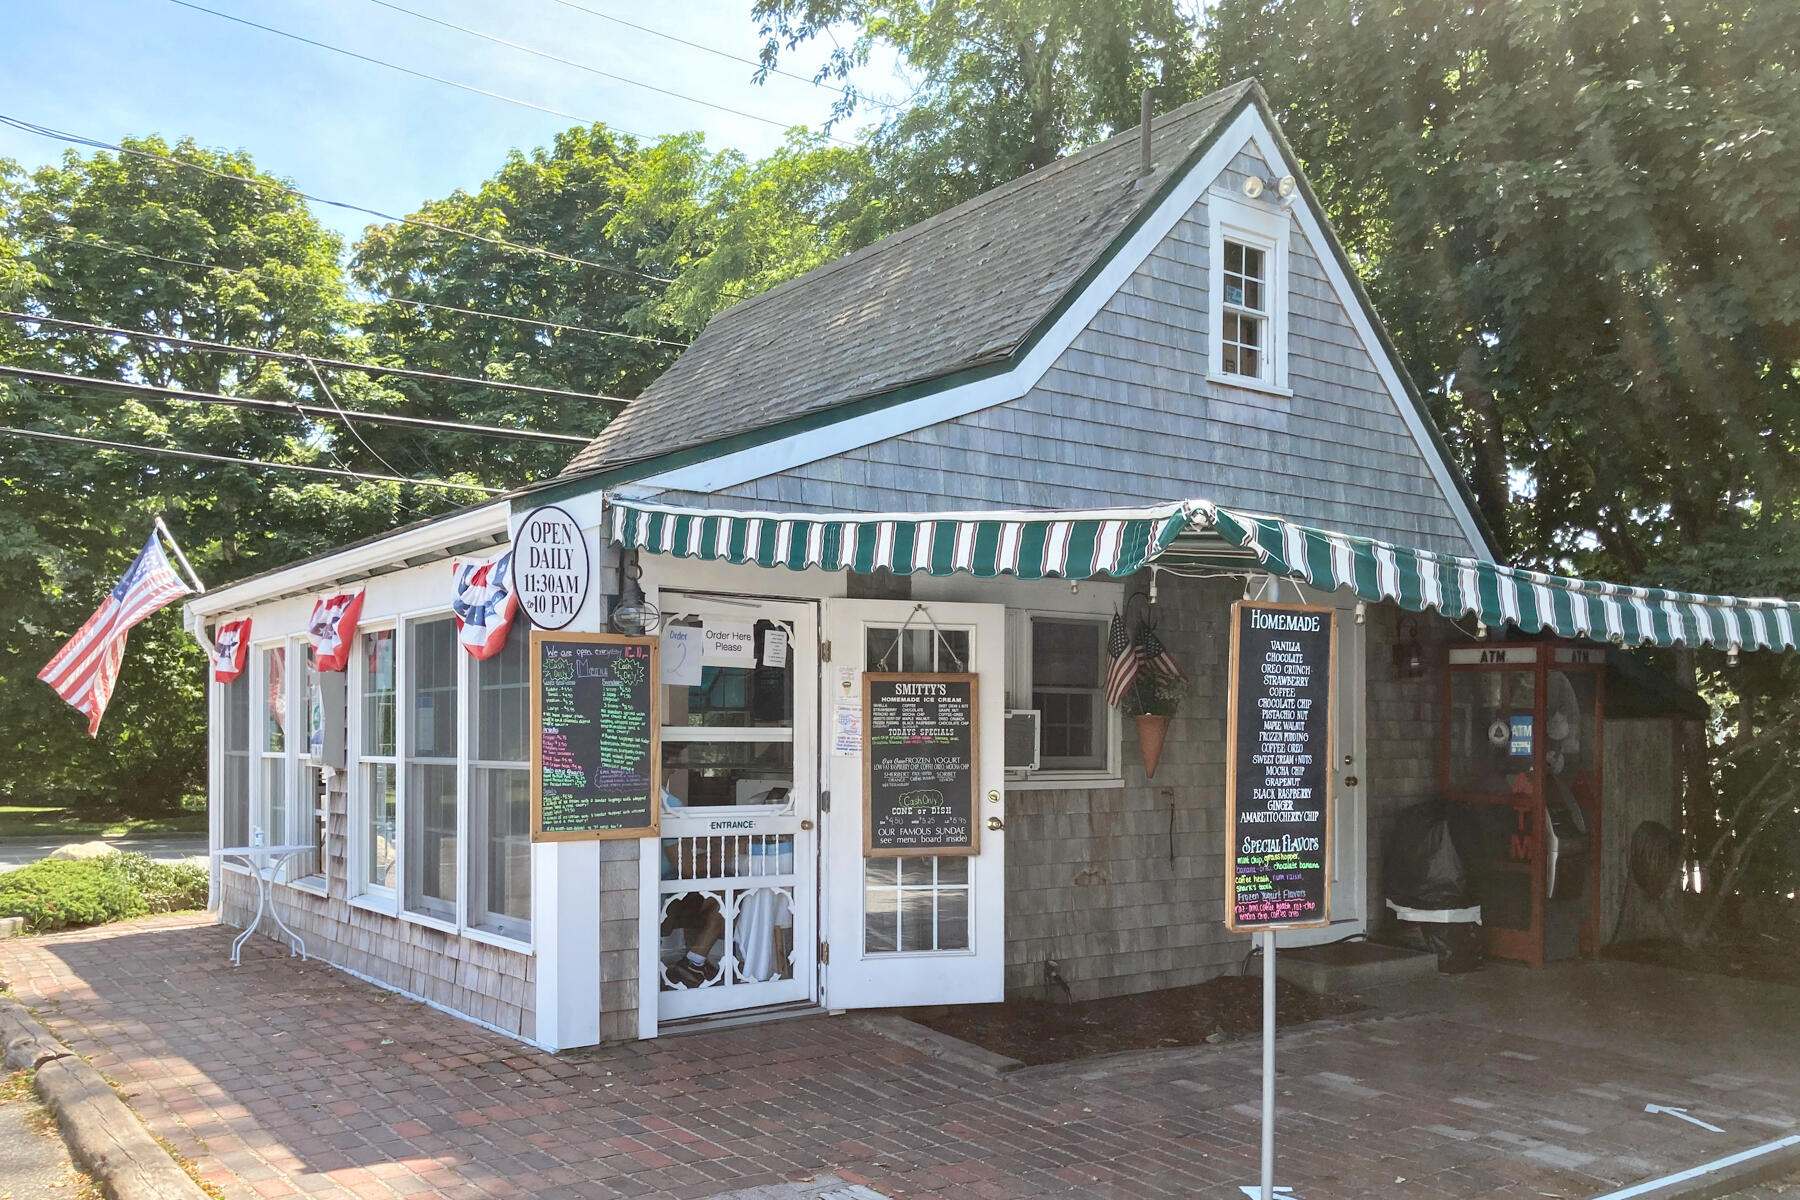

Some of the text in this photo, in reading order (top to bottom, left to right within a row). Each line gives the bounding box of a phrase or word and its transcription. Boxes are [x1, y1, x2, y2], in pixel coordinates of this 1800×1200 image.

[530, 521, 572, 544] OPEN
[529, 547, 574, 570] DAILY
[524, 574, 579, 594] 11:30AM
[534, 595, 546, 613] 10
[551, 595, 573, 614] PM
[1251, 609, 1320, 632] HOMEMADE
[705, 630, 752, 641] Order Here
[545, 645, 559, 658] We
[560, 649, 573, 657] are
[576, 648, 593, 657] open
[715, 642, 742, 652] Please
[1270, 640, 1301, 652] VANILLA
[1266, 652, 1304, 663] CHOCOLATE
[1480, 651, 1506, 663] ATM
[1261, 664, 1311, 675] OREO CRUNCH
[1263, 674, 1310, 687] STRAWBERRY
[895, 683, 947, 695] SMITTY'S
[1269, 687, 1296, 697] COFFEE
[1257, 698, 1312, 709] CHOCOLATE CHIP
[1262, 709, 1309, 720] PISTACHIO NUT
[1263, 721, 1305, 731] MAPLE WALNUT
[1511, 725, 1532, 737] ATM
[889, 728, 955, 736] TODAYS SPECIALS
[1259, 732, 1309, 742] FROZEN PUDDING
[1261, 743, 1304, 753] COFFEE OREO
[934, 756, 961, 764] YOGURT
[1252, 755, 1275, 764] SWEET
[1275, 755, 1294, 764] CREAM
[1298, 755, 1313, 764] NUTS
[1265, 766, 1305, 776] MOCHA CHIP
[1265, 777, 1301, 787] GRAPENUT
[1253, 788, 1312, 799] BLACK RASPBERRY
[903, 796, 921, 806] Cash
[1267, 800, 1294, 810] GINGER
[892, 807, 913, 815] CONE
[932, 807, 952, 815] DISH
[1240, 810, 1320, 823] AMARETTO CHERRY CHIP
[711, 821, 753, 829] ENTRANCE
[878, 827, 966, 836] OUR FAMOUS SUNDAE
[920, 835, 942, 843] board
[946, 834, 968, 843] inside)
